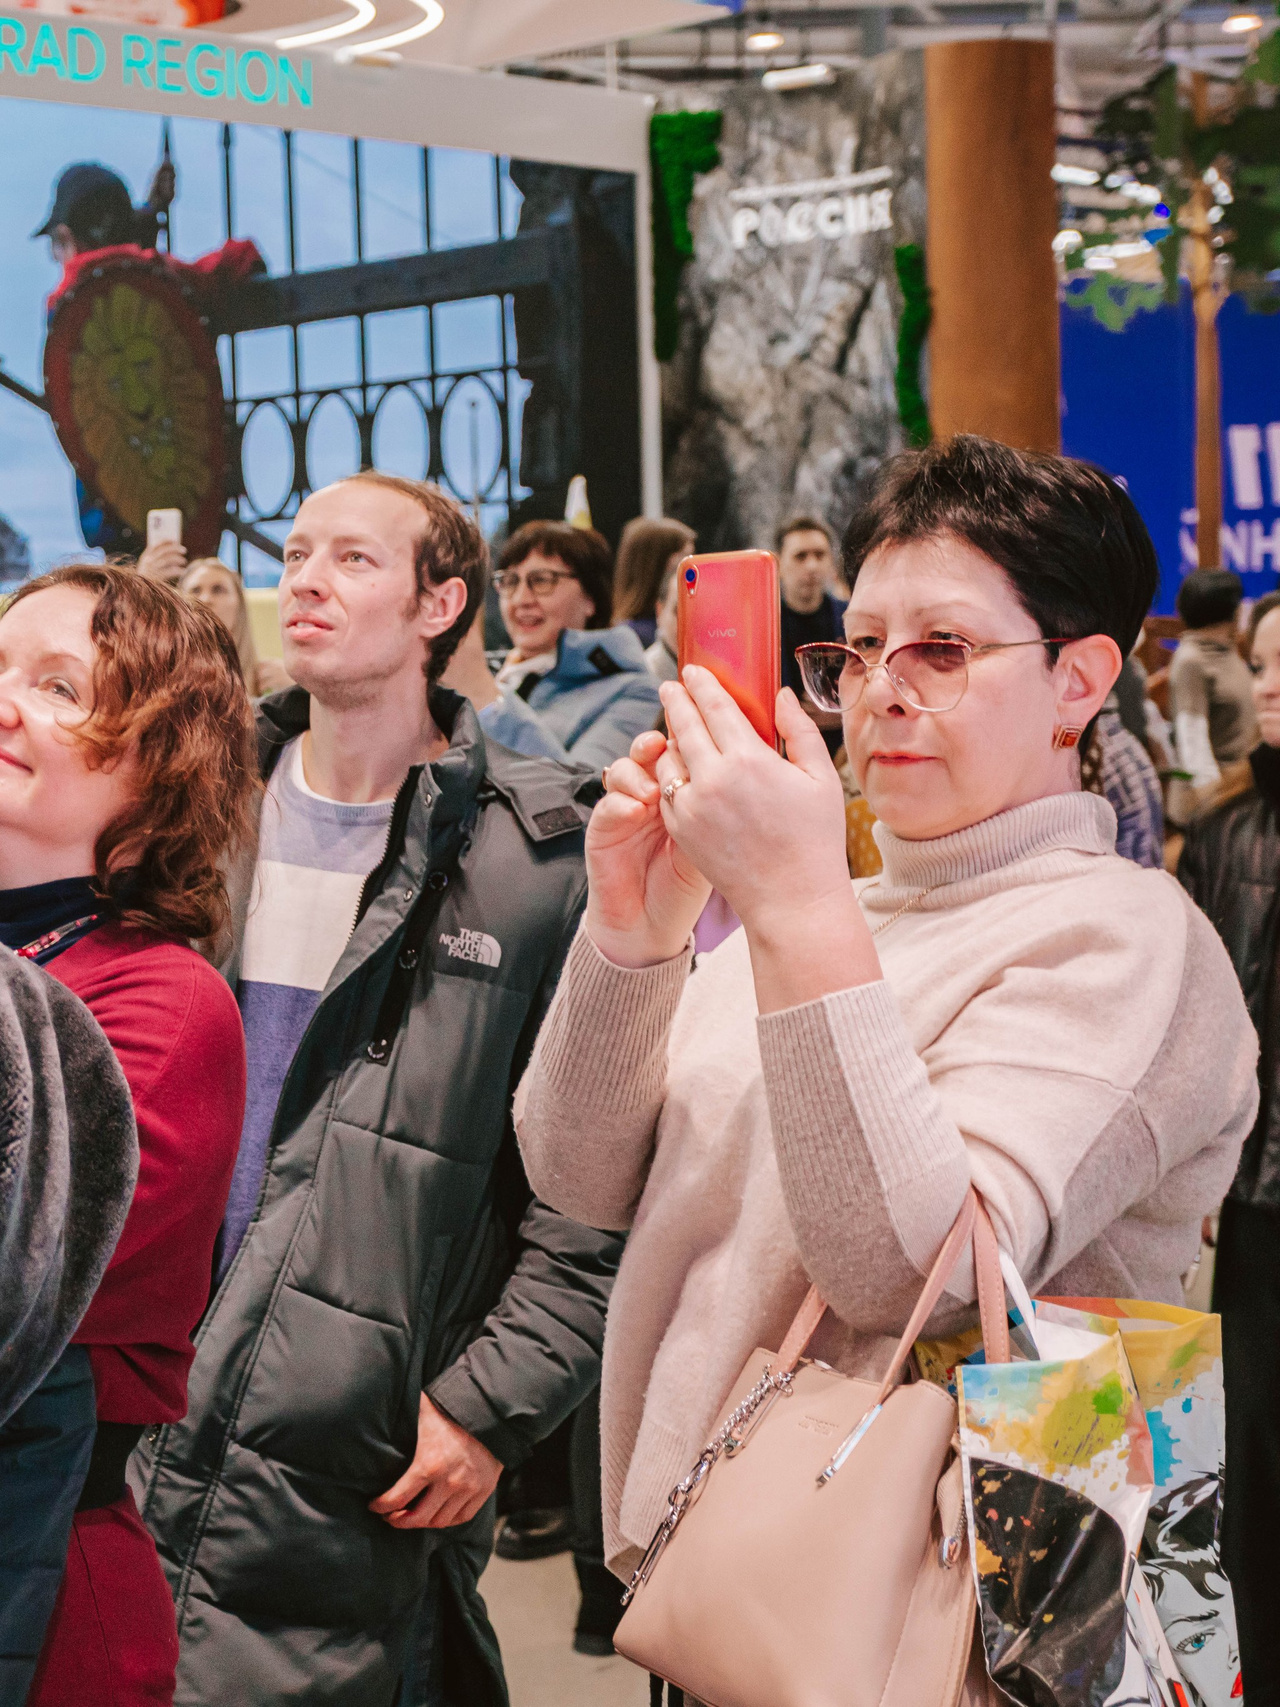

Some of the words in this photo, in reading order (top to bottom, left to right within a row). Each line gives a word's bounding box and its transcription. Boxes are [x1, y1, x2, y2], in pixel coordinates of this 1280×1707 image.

[121, 34, 313, 107] REGION
[439, 933, 481, 953] NORTH
[460, 928, 483, 943] THE
[448, 945, 478, 962] FACE
